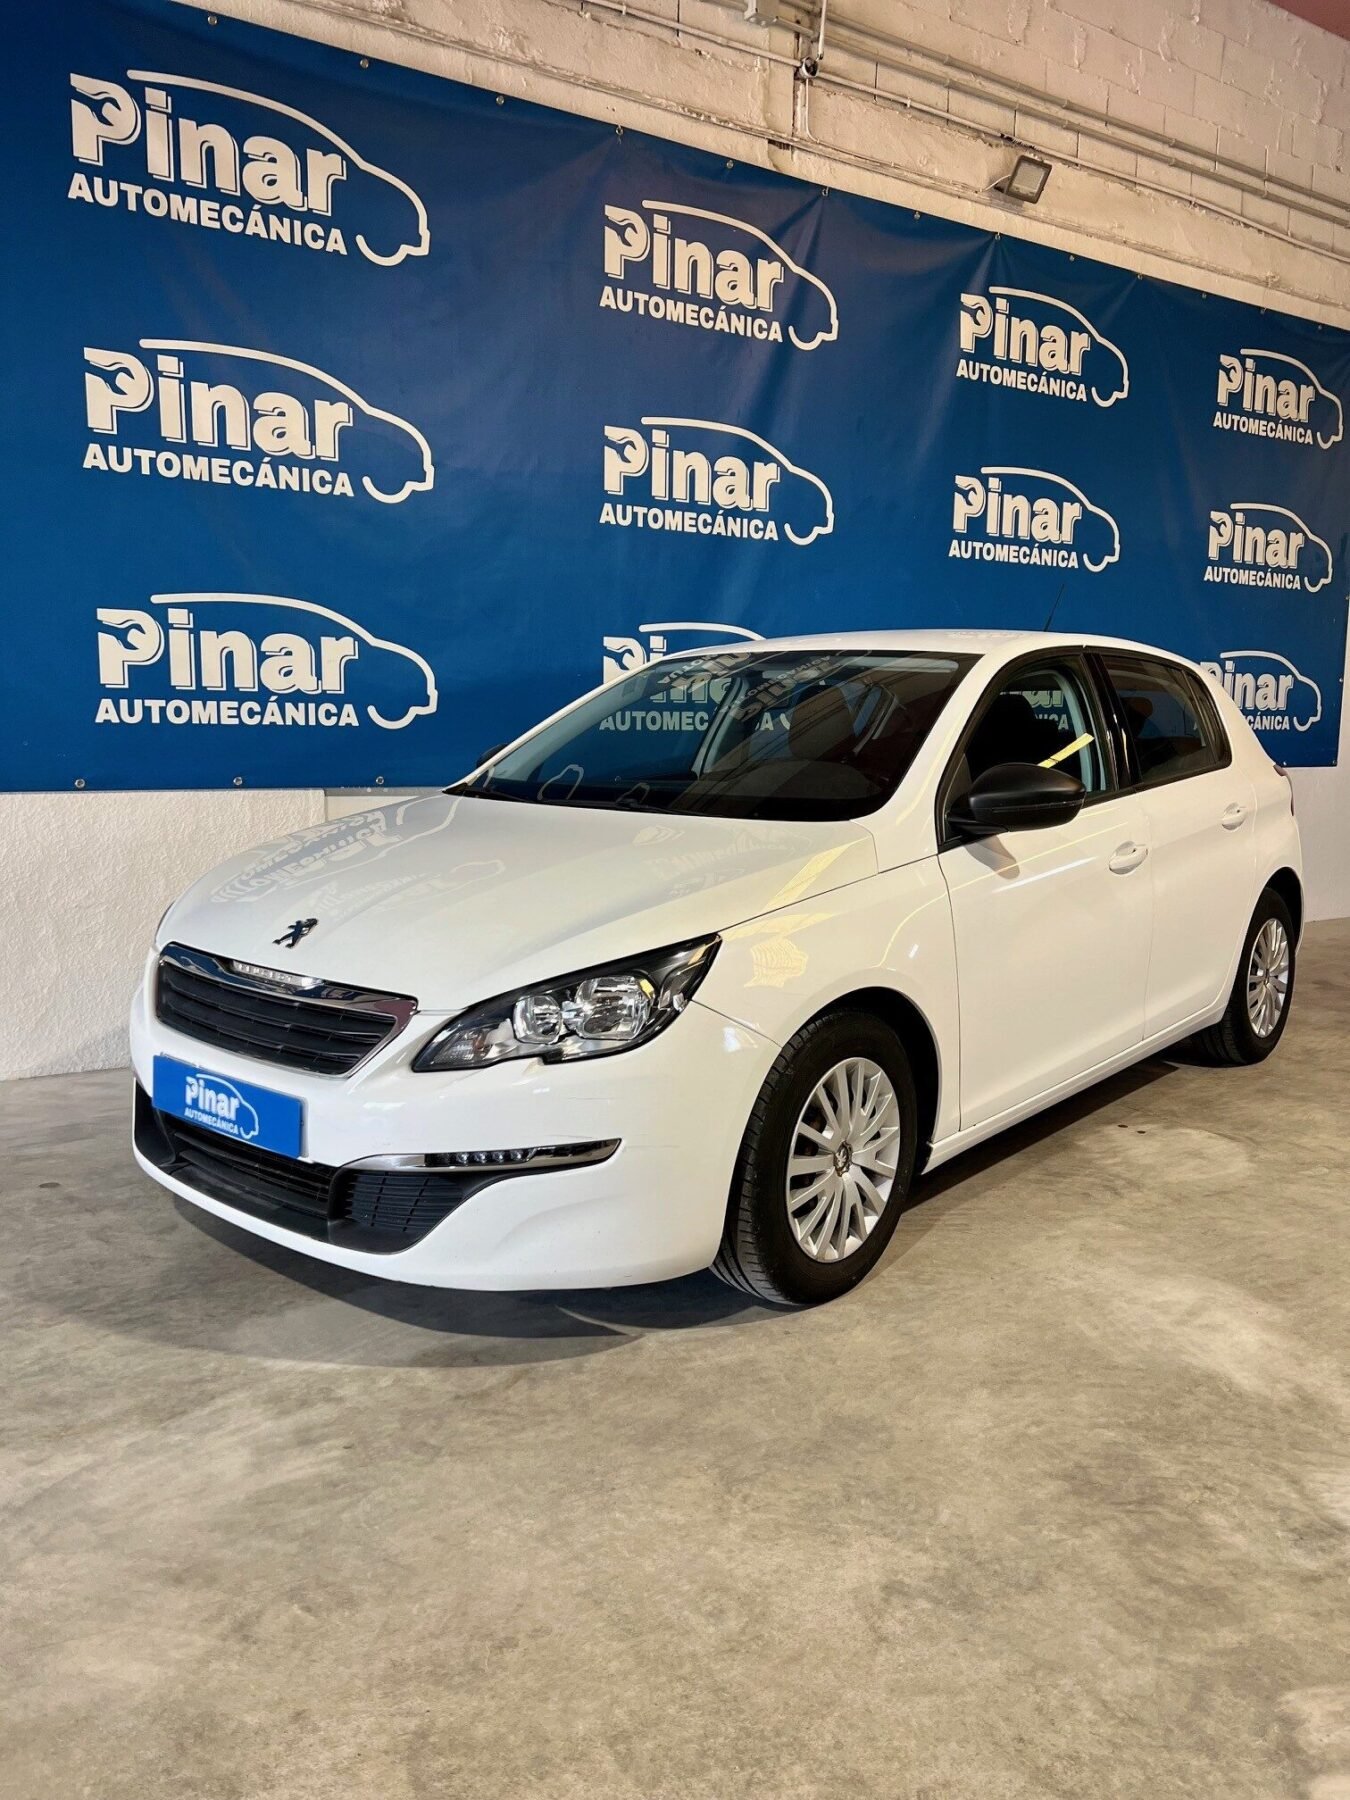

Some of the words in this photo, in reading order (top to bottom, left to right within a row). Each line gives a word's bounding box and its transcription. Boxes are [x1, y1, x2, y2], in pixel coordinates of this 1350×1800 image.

[70, 73, 347, 216] Pinar
[67, 172, 348, 256] AUTOMECÁNICA
[604, 204, 784, 312] Pinar
[600, 285, 783, 343] AUTOMECÁNICA
[960, 293, 1091, 376] Pinar
[84, 347, 353, 462] Pinar
[956, 359, 1088, 402] AUTOMECÁNICA
[1217, 354, 1315, 423] Pinar
[1213, 411, 1313, 445] AUTOMECÁNICA
[83, 443, 354, 497] AUTOMECÁNICA
[604, 425, 780, 512] Pinar
[600, 503, 779, 541] AUTOMECÁNICA
[953, 475, 1082, 544] Pinar
[948, 539, 1079, 569] AUTOMECÁNICA
[1208, 510, 1305, 569] Pinar
[1203, 566, 1301, 590] AUTOMECÁNICA
[97, 608, 358, 694] Pinar
[95, 696, 359, 727] AUTOMECÁNICA
[185, 1076, 239, 1121] Pinar
